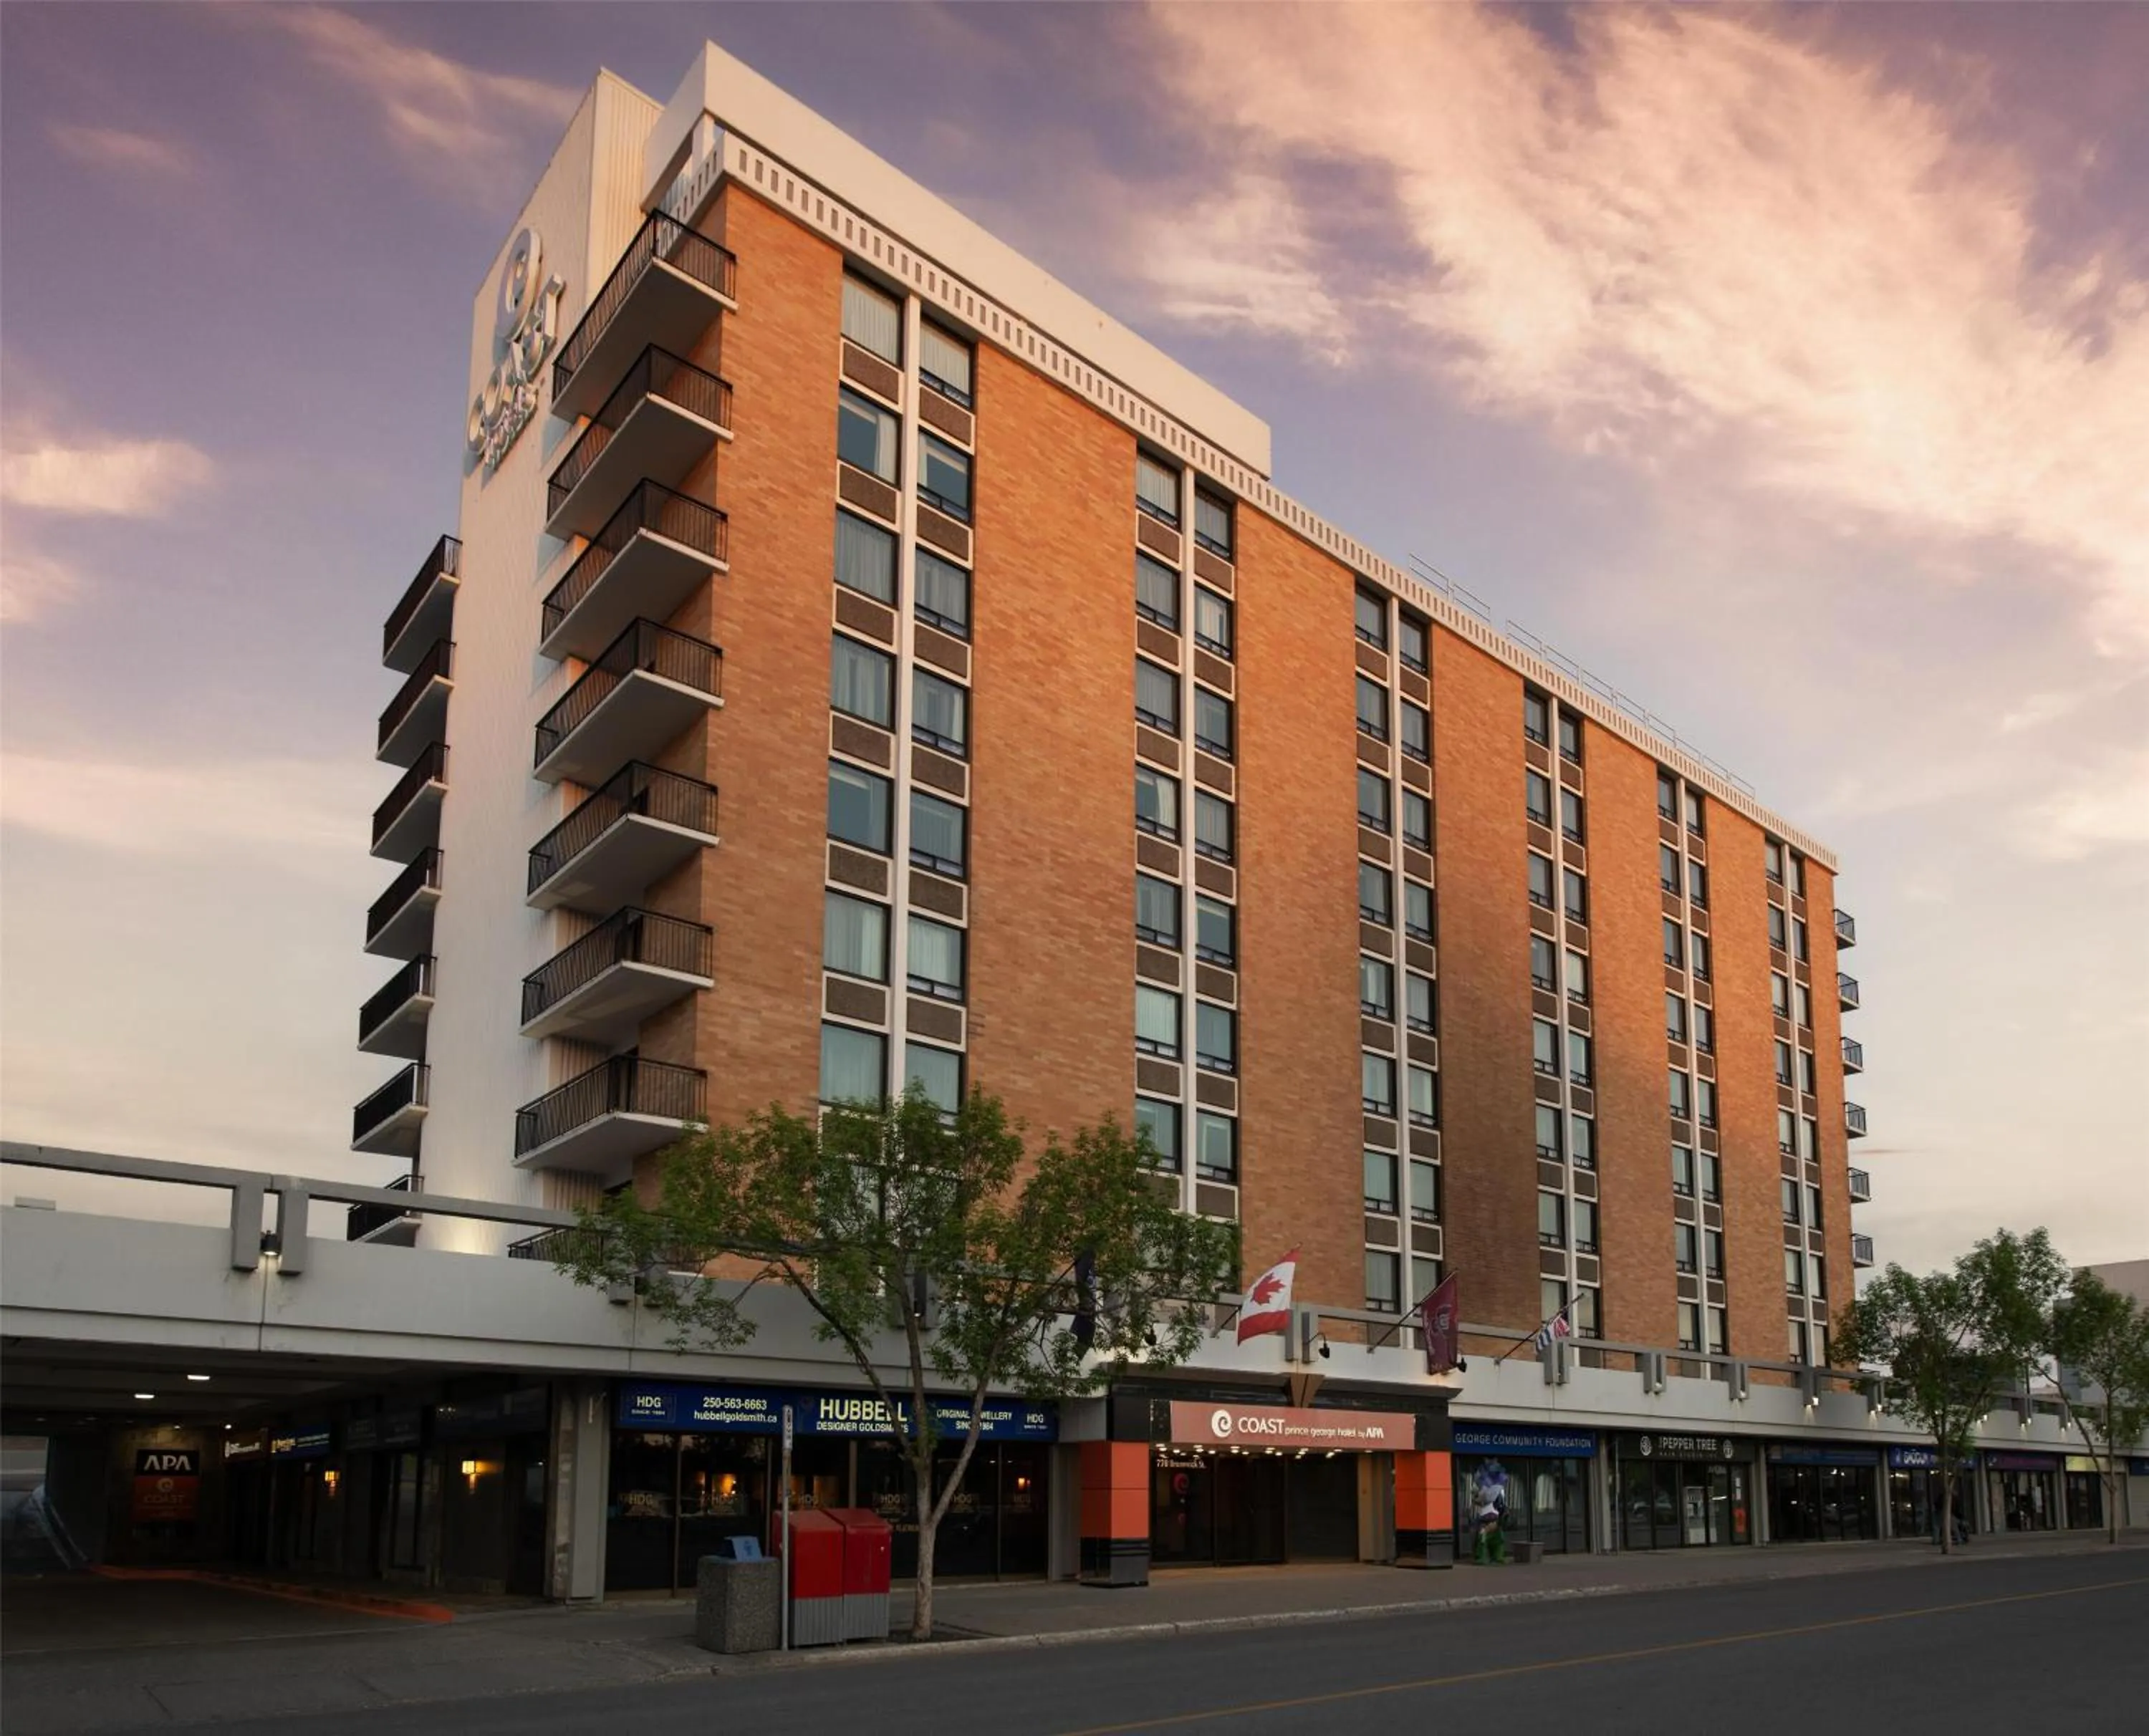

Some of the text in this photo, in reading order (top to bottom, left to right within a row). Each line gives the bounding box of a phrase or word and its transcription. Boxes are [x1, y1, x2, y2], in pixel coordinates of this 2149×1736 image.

[636, 1396, 662, 1409] HDG
[703, 1396, 767, 1411] 250-563-6663
[694, 1409, 777, 1424] hubbellgoldsmith.ca
[936, 1409, 1013, 1421] ORIGINAL WELLERY
[1027, 1413, 1044, 1424] HDG
[817, 1421, 909, 1433] DESIGNER GOLDSMS
[955, 1420, 972, 1430] SINC
[1239, 1417, 1285, 1434] COAST
[1285, 1425, 1309, 1437] prince
[1310, 1427, 1337, 1438] george
[1337, 1427, 1356, 1437] hotel
[1366, 1427, 1384, 1438] APA
[1455, 1433, 1592, 1448] GEORGE COMMUNITY FOUNDATION
[1663, 1437, 1694, 1450] PEPPER
[1696, 1438, 1718, 1450] TREE
[143, 1455, 192, 1471] APA
[628, 1493, 654, 1505] HDG
